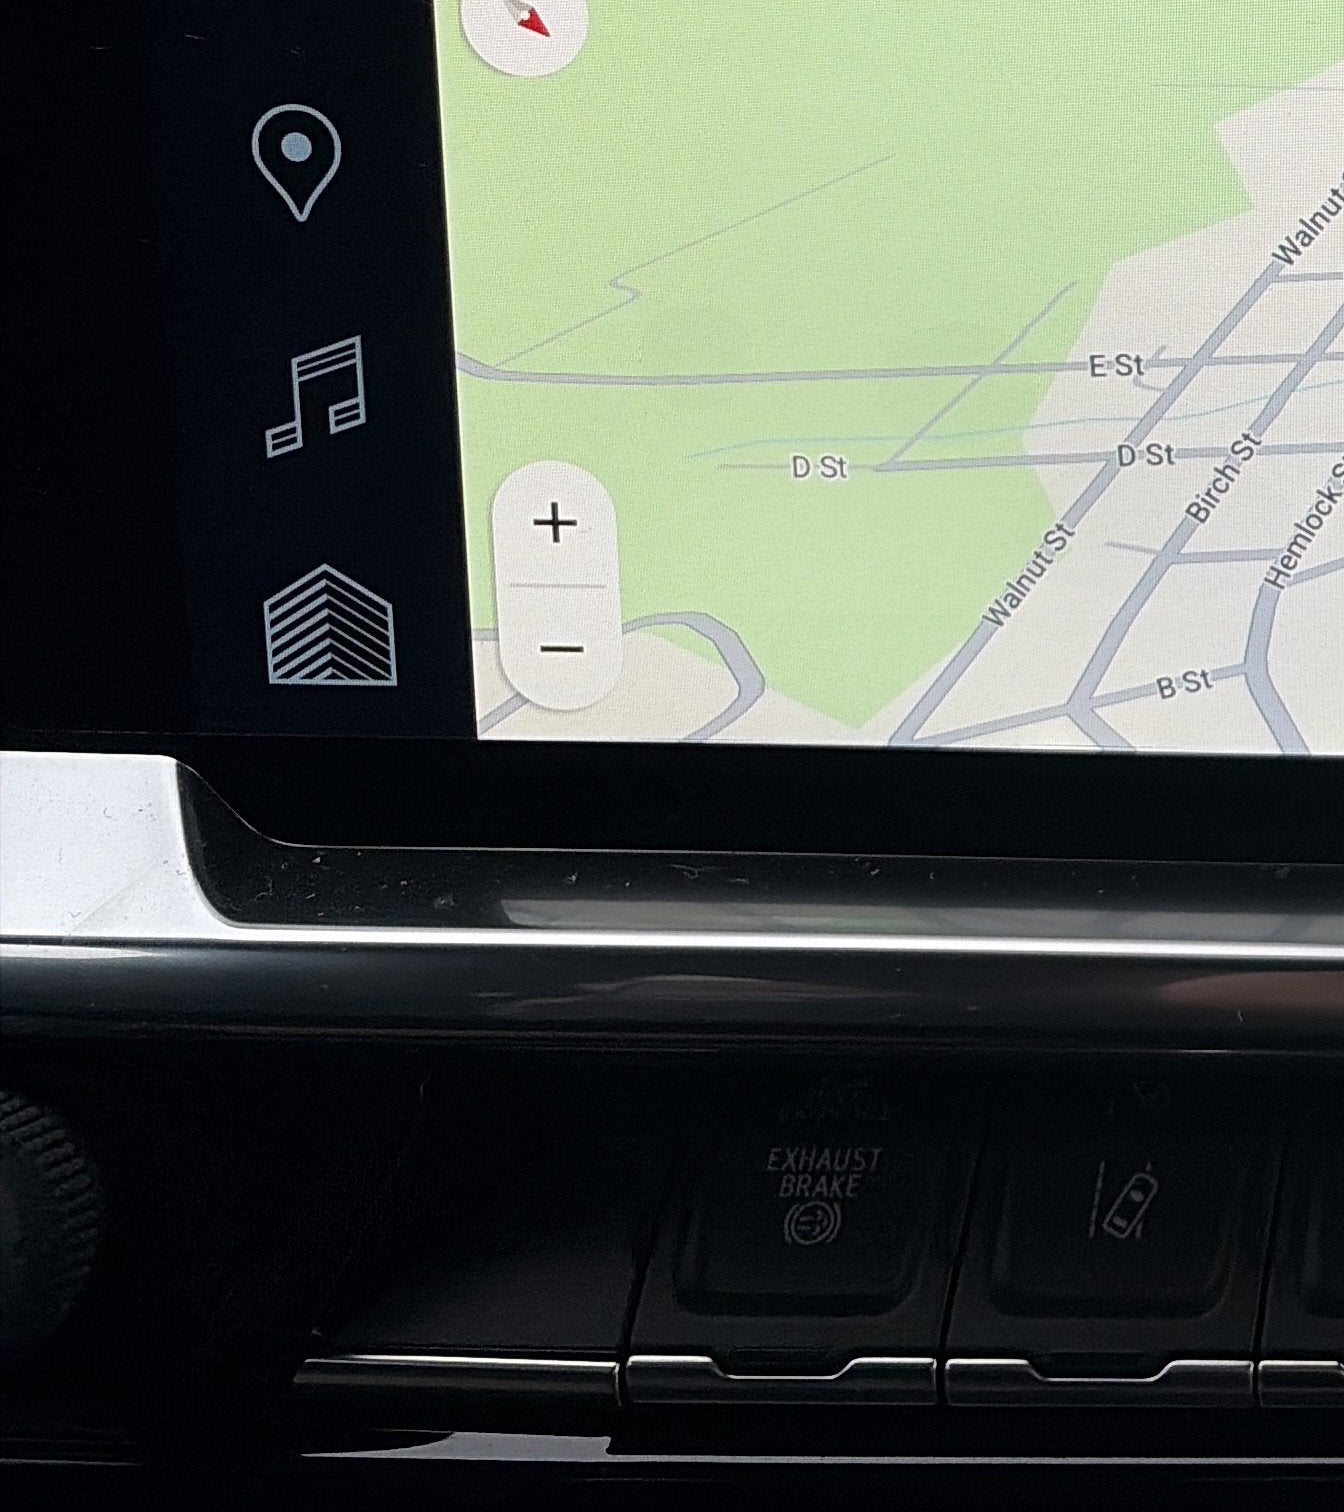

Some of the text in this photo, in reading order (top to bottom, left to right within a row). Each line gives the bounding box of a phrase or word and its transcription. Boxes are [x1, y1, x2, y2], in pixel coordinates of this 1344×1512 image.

[1090, 354, 1144, 377] E St
[792, 455, 846, 478] D St
[1118, 444, 1175, 466] D St
[1186, 431, 1262, 524] Birch St
[1265, 484, 1340, 589] Hemlock
[982, 522, 1075, 628] Walnut St
[1157, 670, 1213, 698] B St
[767, 1147, 881, 1172] EXHAUST
[780, 1174, 859, 1199] BRAKE
